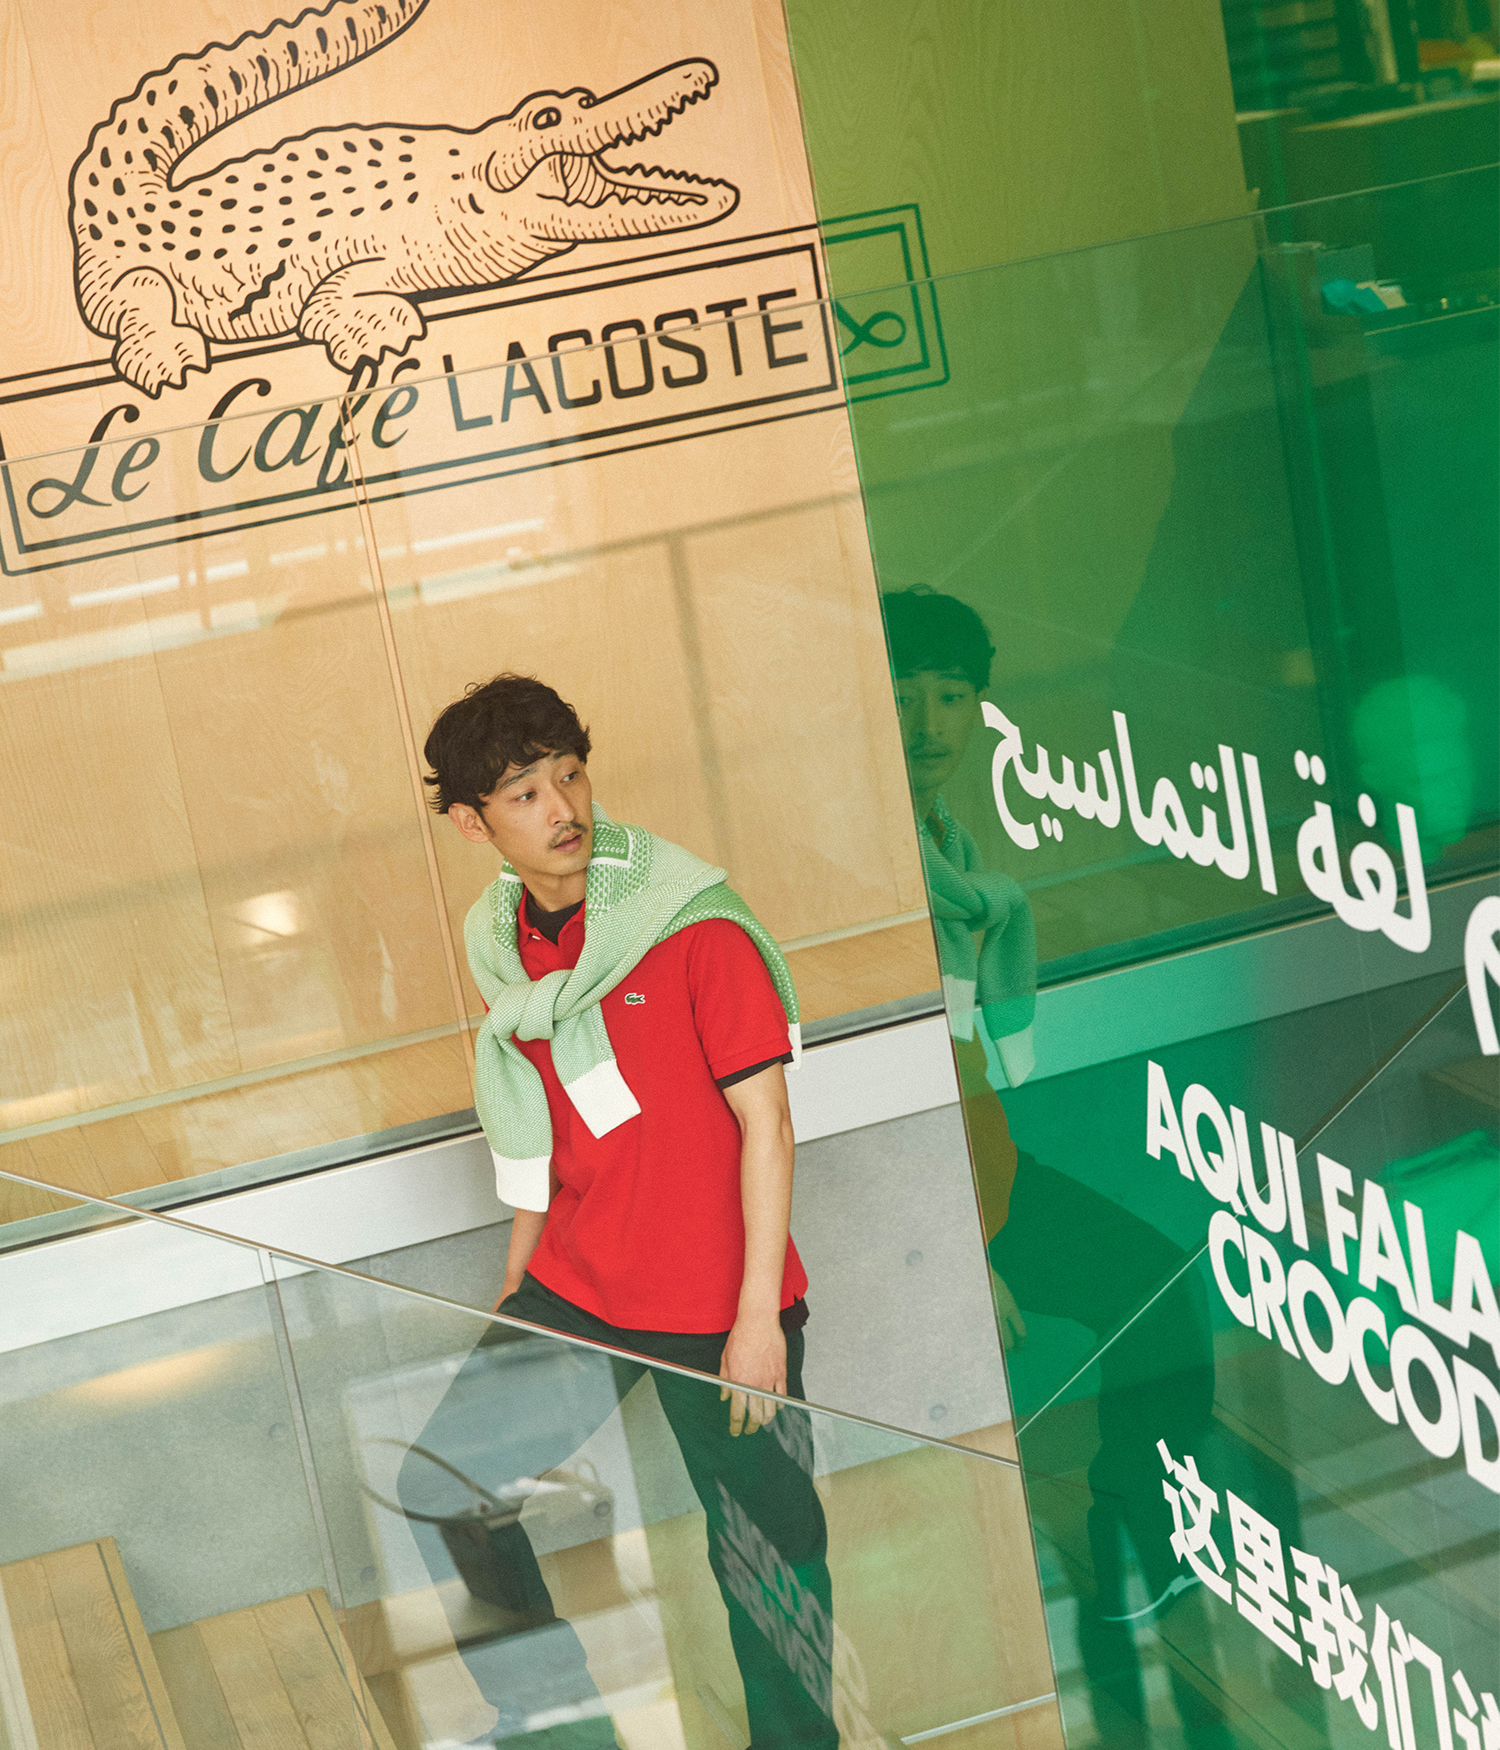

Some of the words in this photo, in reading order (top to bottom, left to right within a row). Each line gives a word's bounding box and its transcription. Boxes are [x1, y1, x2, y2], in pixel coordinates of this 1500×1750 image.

[26, 403, 161, 519] Le
[197, 355, 421, 492] Café
[442, 287, 809, 432] LACOSTE
[979, 700, 1278, 896] التماسيح
[1294, 749, 1432, 953] لغة
[1145, 1059, 1310, 1252] AQUI
[1316, 1151, 1500, 1370] FALA
[1207, 1209, 1500, 1495] CROCOD
